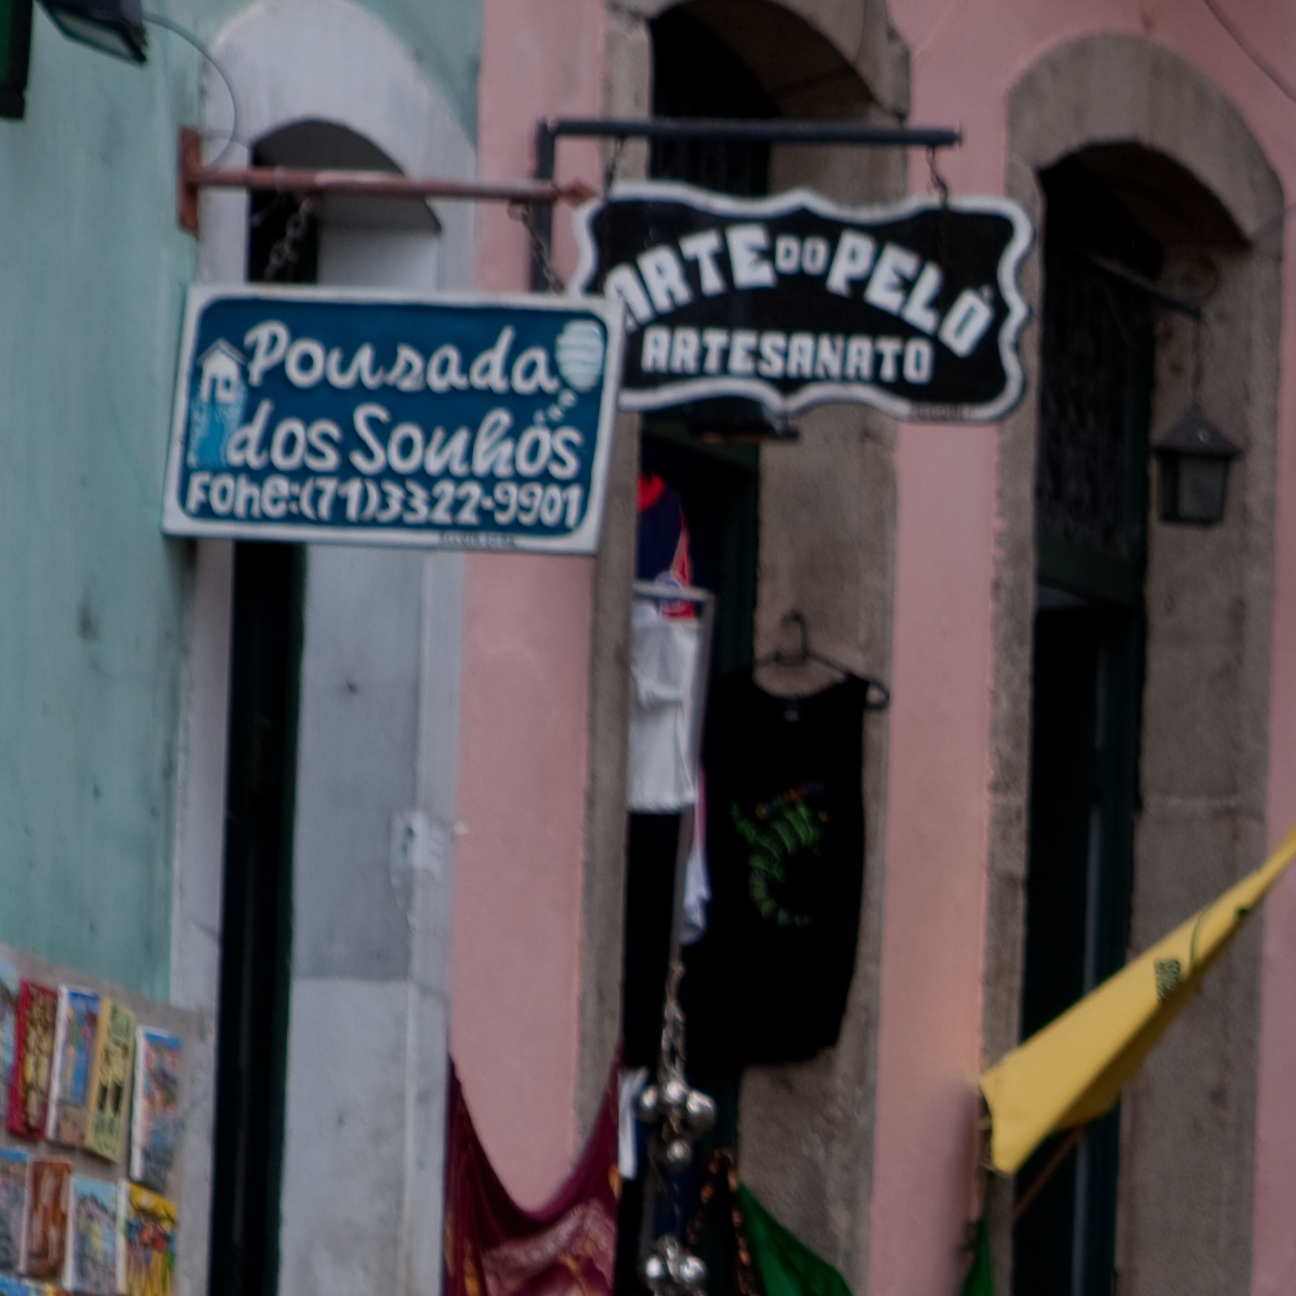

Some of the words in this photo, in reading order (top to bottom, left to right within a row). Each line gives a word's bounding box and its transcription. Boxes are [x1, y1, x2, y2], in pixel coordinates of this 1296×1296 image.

[604, 222, 777, 332] ARTE
[774, 233, 829, 275] DO
[243, 319, 561, 396] Pousada
[641, 325, 934, 385] ARTESANATO
[226, 398, 343, 472] dos
